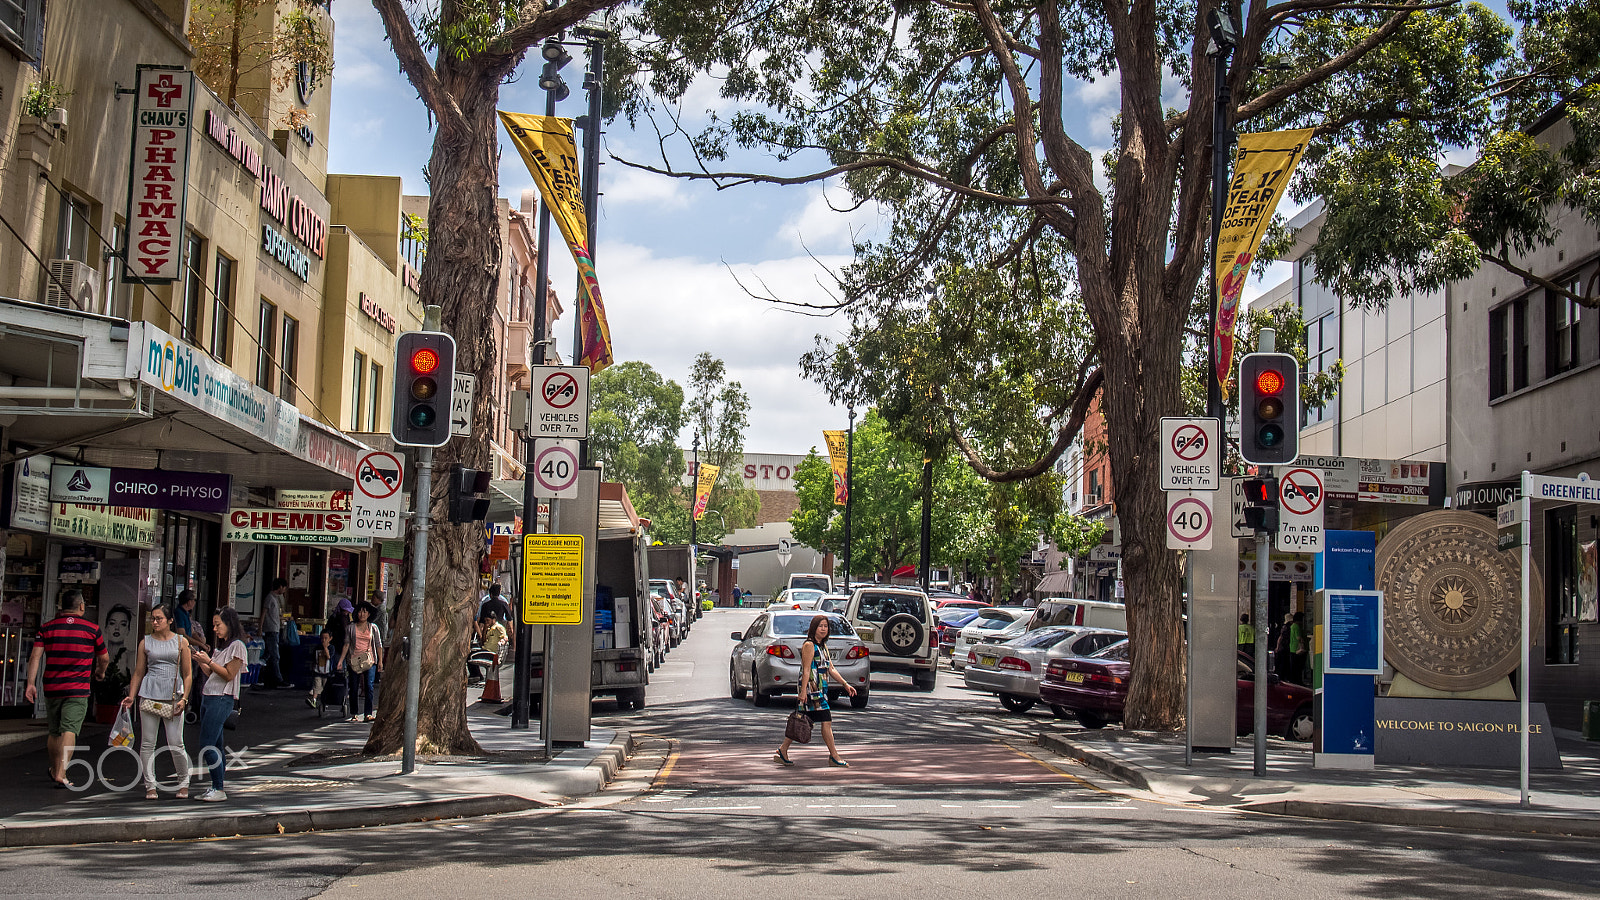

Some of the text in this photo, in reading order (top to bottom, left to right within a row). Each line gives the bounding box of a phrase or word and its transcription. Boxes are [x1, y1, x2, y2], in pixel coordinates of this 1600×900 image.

[140, 111, 186, 128] CHAU'S
[137, 129, 178, 275] PHARMACY
[1229, 188, 1275, 206] YEAR
[1224, 206, 1239, 220] OF
[147, 338, 201, 397] mobile
[204, 373, 266, 424] communications
[540, 413, 579, 422] VEHICLES
[540, 424, 578, 433] OVER 7m
[1292, 457, 1314, 466] ánh
[541, 460, 569, 478] 40
[1171, 465, 1210, 474] VEHICLES
[1171, 476, 1210, 485] OVER 7m
[114, 481, 222, 500] CHIRO PHYSIO
[1403, 485, 1424, 495] DRINK
[1473, 487, 1521, 505] LOUNGE
[1400, 495, 1418, 503] 313
[356, 506, 395, 518] 7m AND
[356, 519, 393, 531] OVER
[1174, 511, 1203, 529] 40
[1282, 522, 1320, 533] 7m AND
[1284, 535, 1317, 545] OVER
[1376, 720, 1434, 731] WELCOME
[1437, 721, 1454, 731] TO
[1457, 722, 1503, 733] SAIGON
